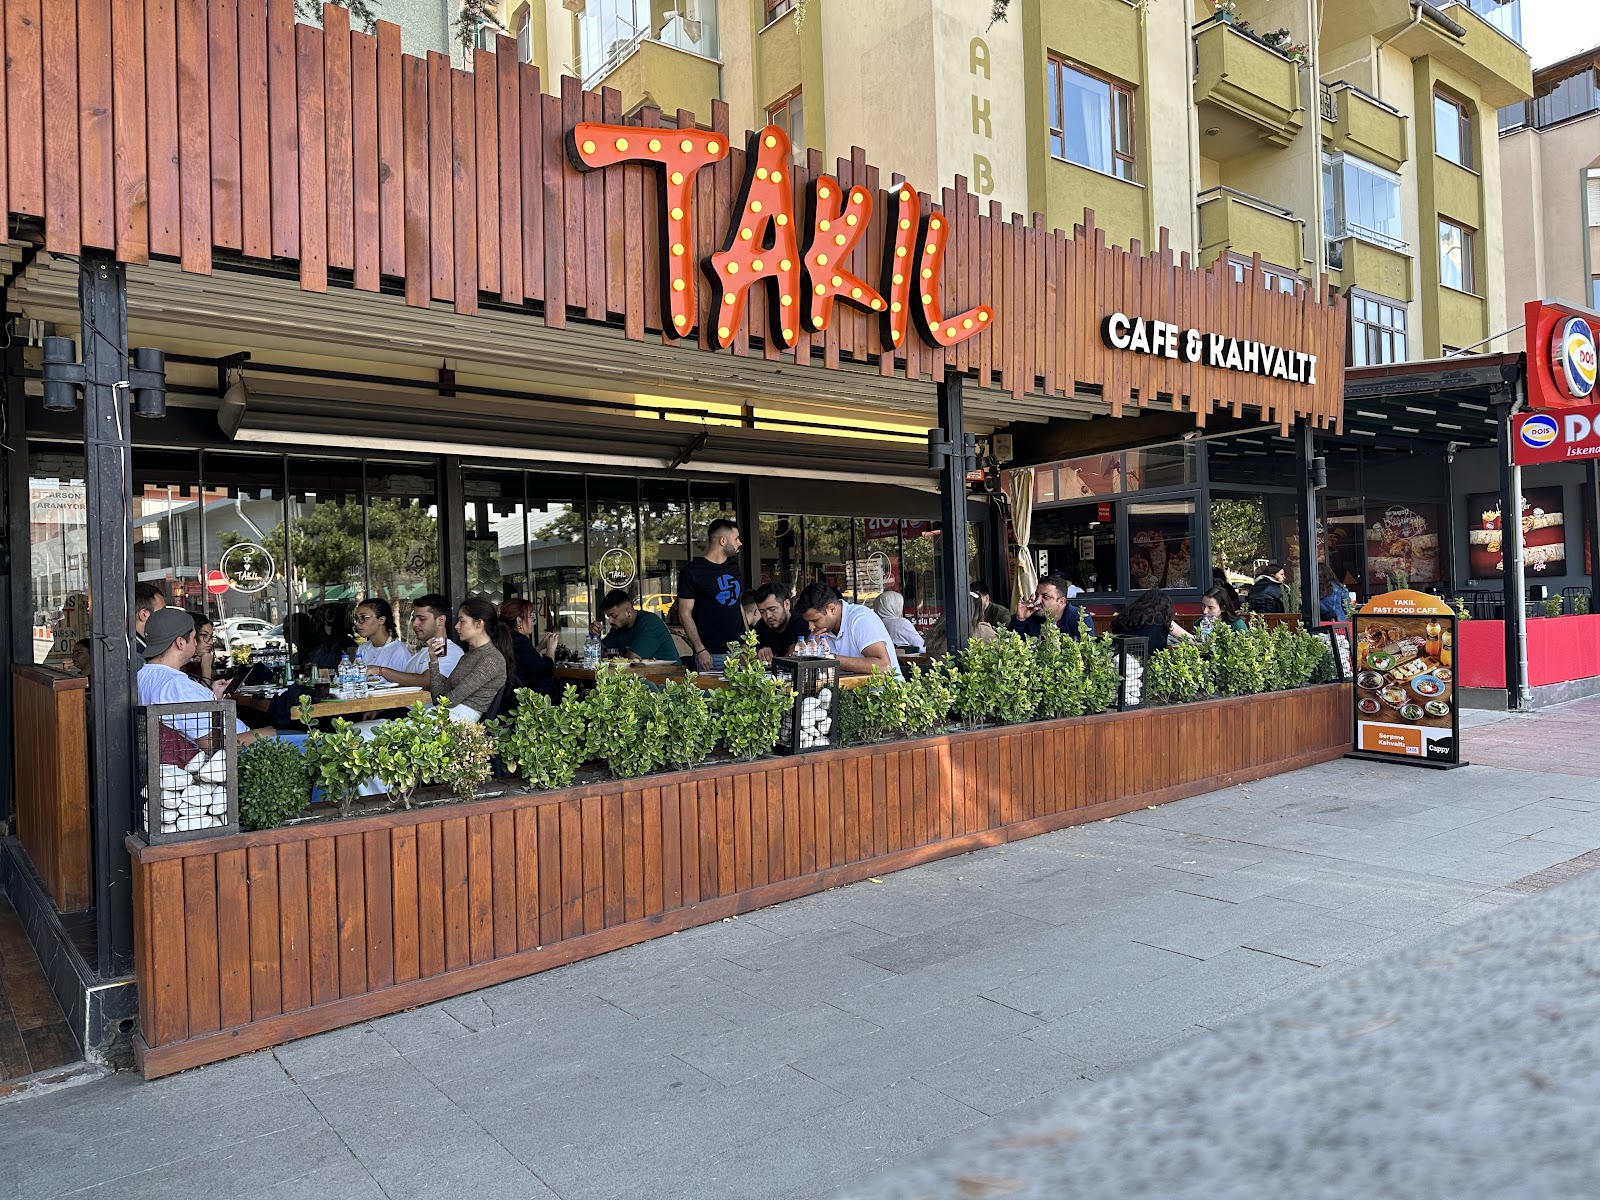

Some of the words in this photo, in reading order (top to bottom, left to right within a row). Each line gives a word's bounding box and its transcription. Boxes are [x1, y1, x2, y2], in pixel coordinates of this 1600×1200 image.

[566, 121, 995, 352] TAKIL
[1103, 312, 1179, 360] CAFE
[1182, 328, 1203, 363] &
[1205, 332, 1318, 385] KAHVALTI
[1378, 732, 1405, 741] Serpme
[1428, 744, 1450, 754] Cappy
